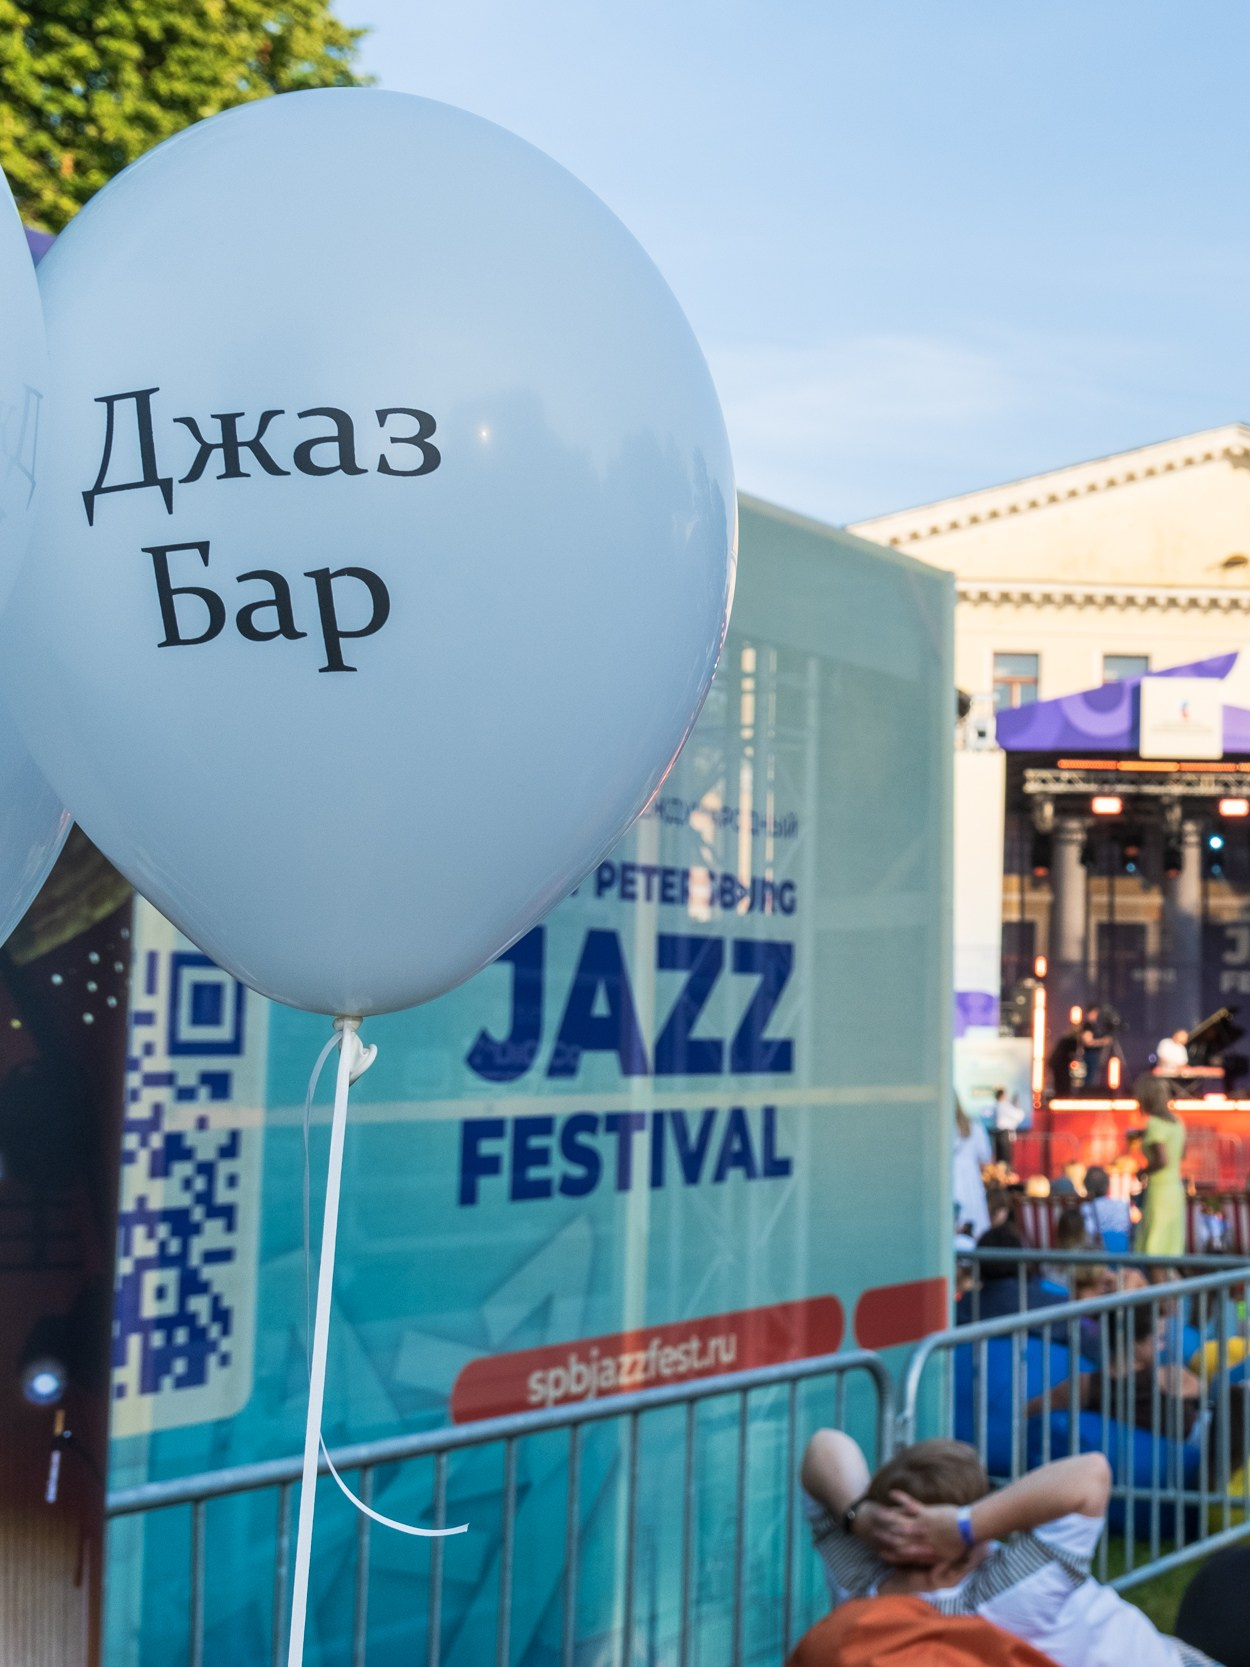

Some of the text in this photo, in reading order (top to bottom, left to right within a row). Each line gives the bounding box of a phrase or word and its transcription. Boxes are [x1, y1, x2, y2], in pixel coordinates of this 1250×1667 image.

[82, 387, 442, 526] Джаз
[141, 540, 391, 673] Бар
[465, 925, 794, 1082] JAZZ
[458, 1105, 793, 1205] FESTIVAL
[528, 1332, 737, 1405] spbjazzfest.ru
